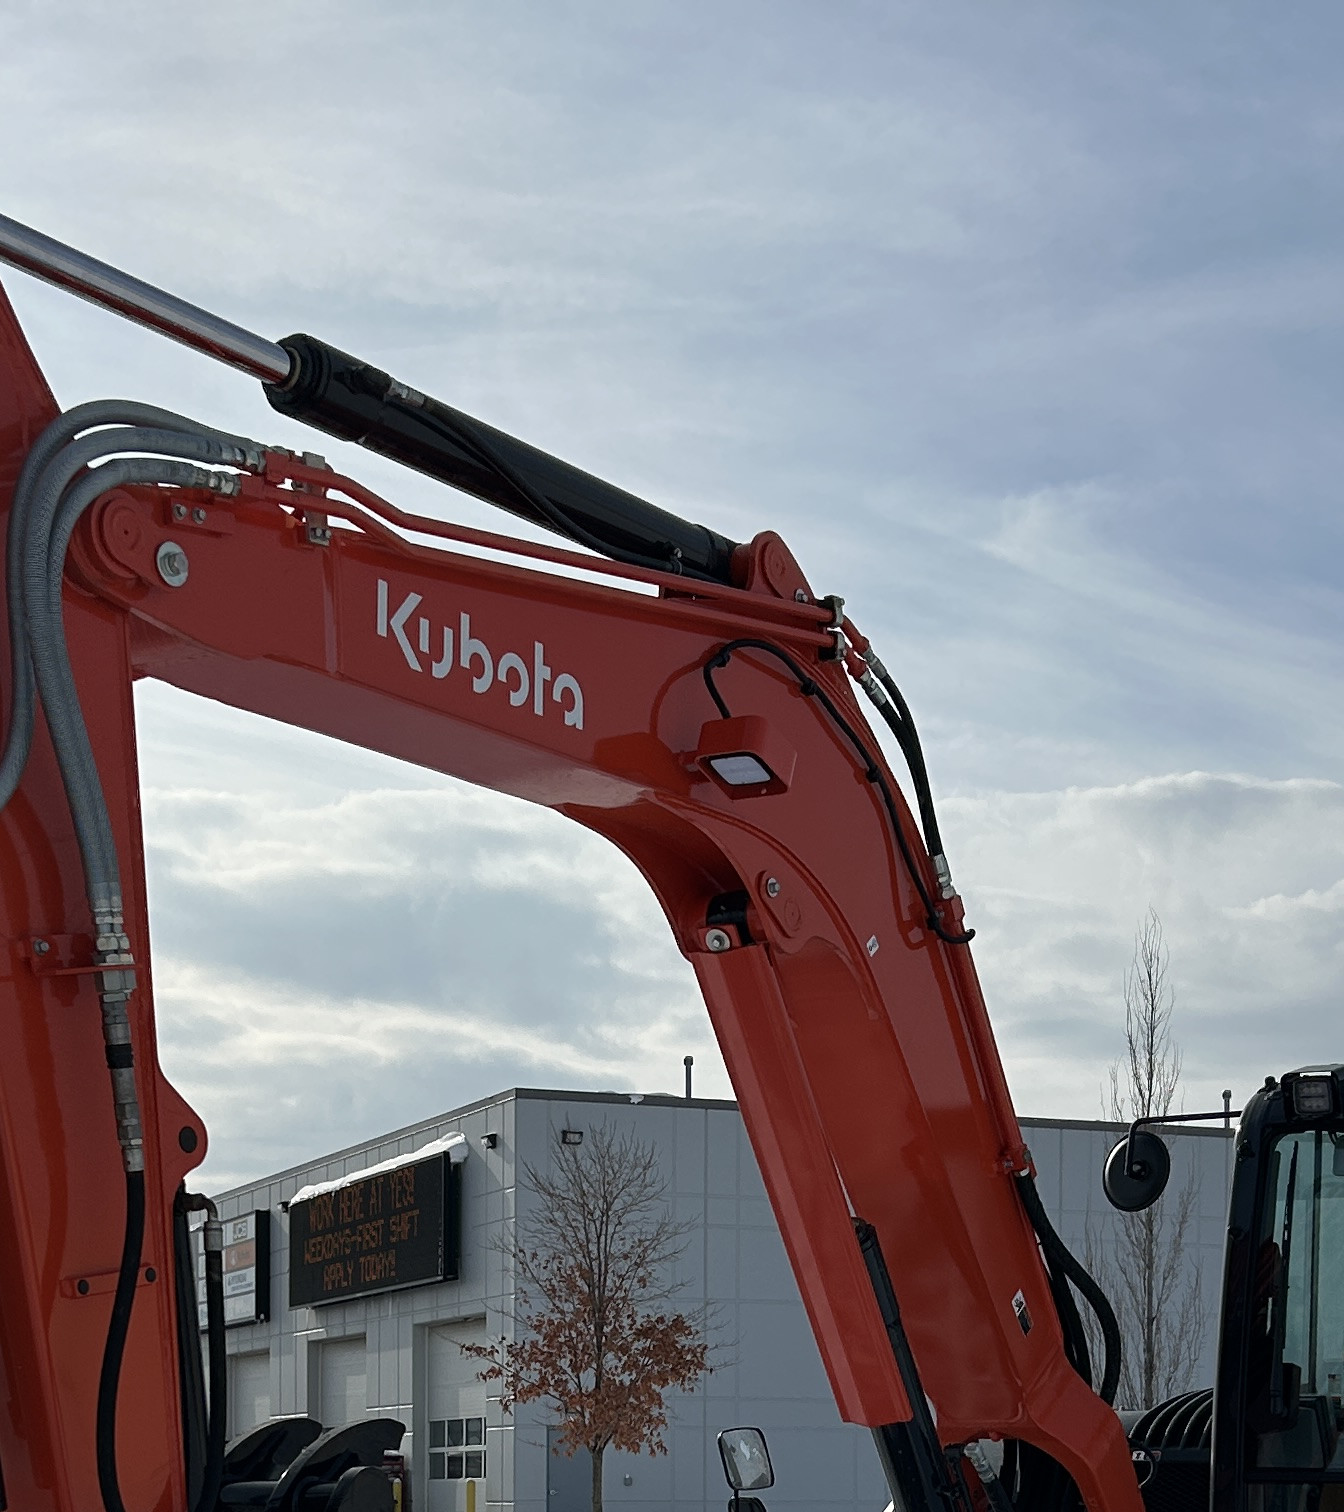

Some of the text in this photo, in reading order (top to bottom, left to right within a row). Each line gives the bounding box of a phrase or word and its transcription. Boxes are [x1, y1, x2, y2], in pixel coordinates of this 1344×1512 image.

[377, 579, 584, 731] Kubota
[339, 1183, 364, 1224] HERE
[370, 1176, 384, 1216] AT
[389, 1209, 420, 1243] SHIFT
[323, 1260, 354, 1291] APPLY
